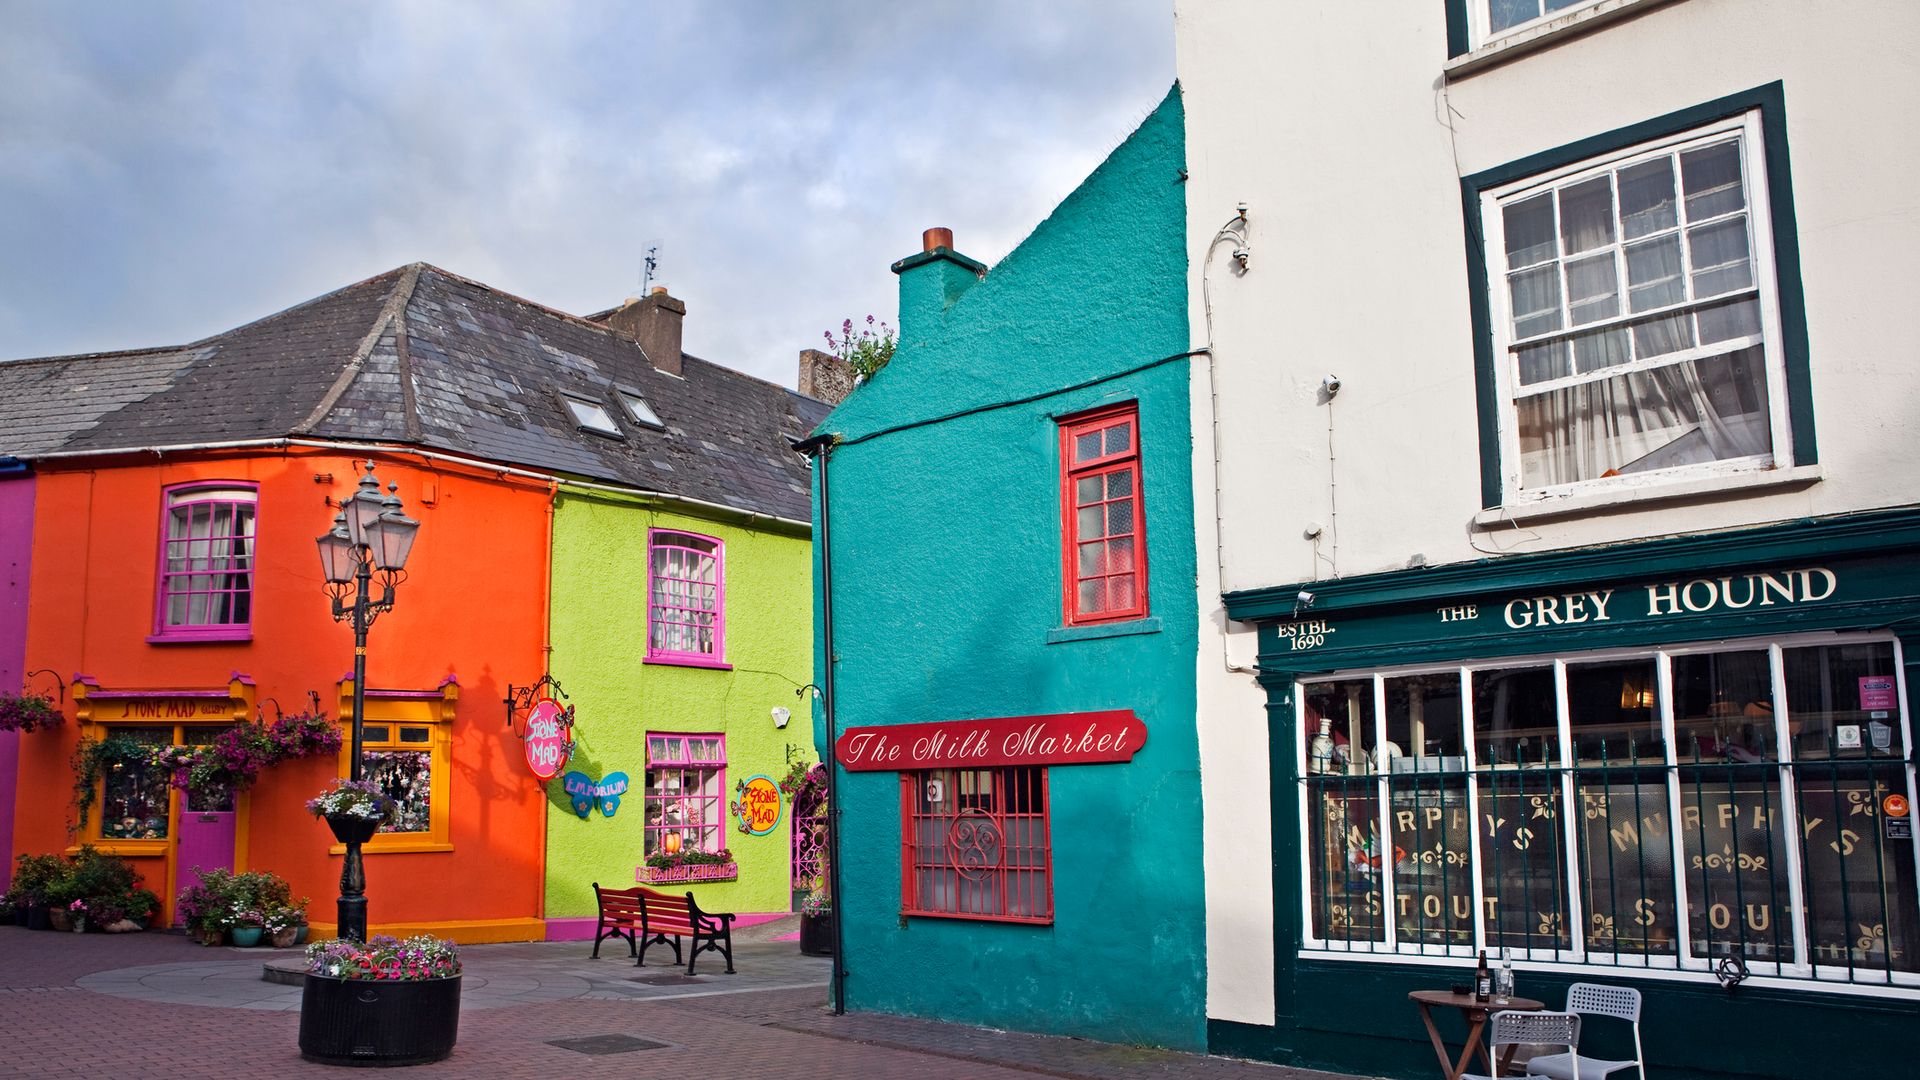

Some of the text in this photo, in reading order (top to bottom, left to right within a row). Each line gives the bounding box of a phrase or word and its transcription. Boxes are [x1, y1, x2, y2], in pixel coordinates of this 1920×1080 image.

[1436, 567, 1837, 629] THE GREY HOUND
[1277, 619, 1336, 638] ESTBL.
[1290, 634, 1325, 650] 1690
[121, 701, 163, 718] STONE
[165, 700, 196, 718] MAD
[846, 722, 1129, 764] The Milk Market
[565, 778, 627, 797] EMPORIUM
[1364, 890, 1499, 920] STOUT
[1634, 898, 1809, 931] SOU
